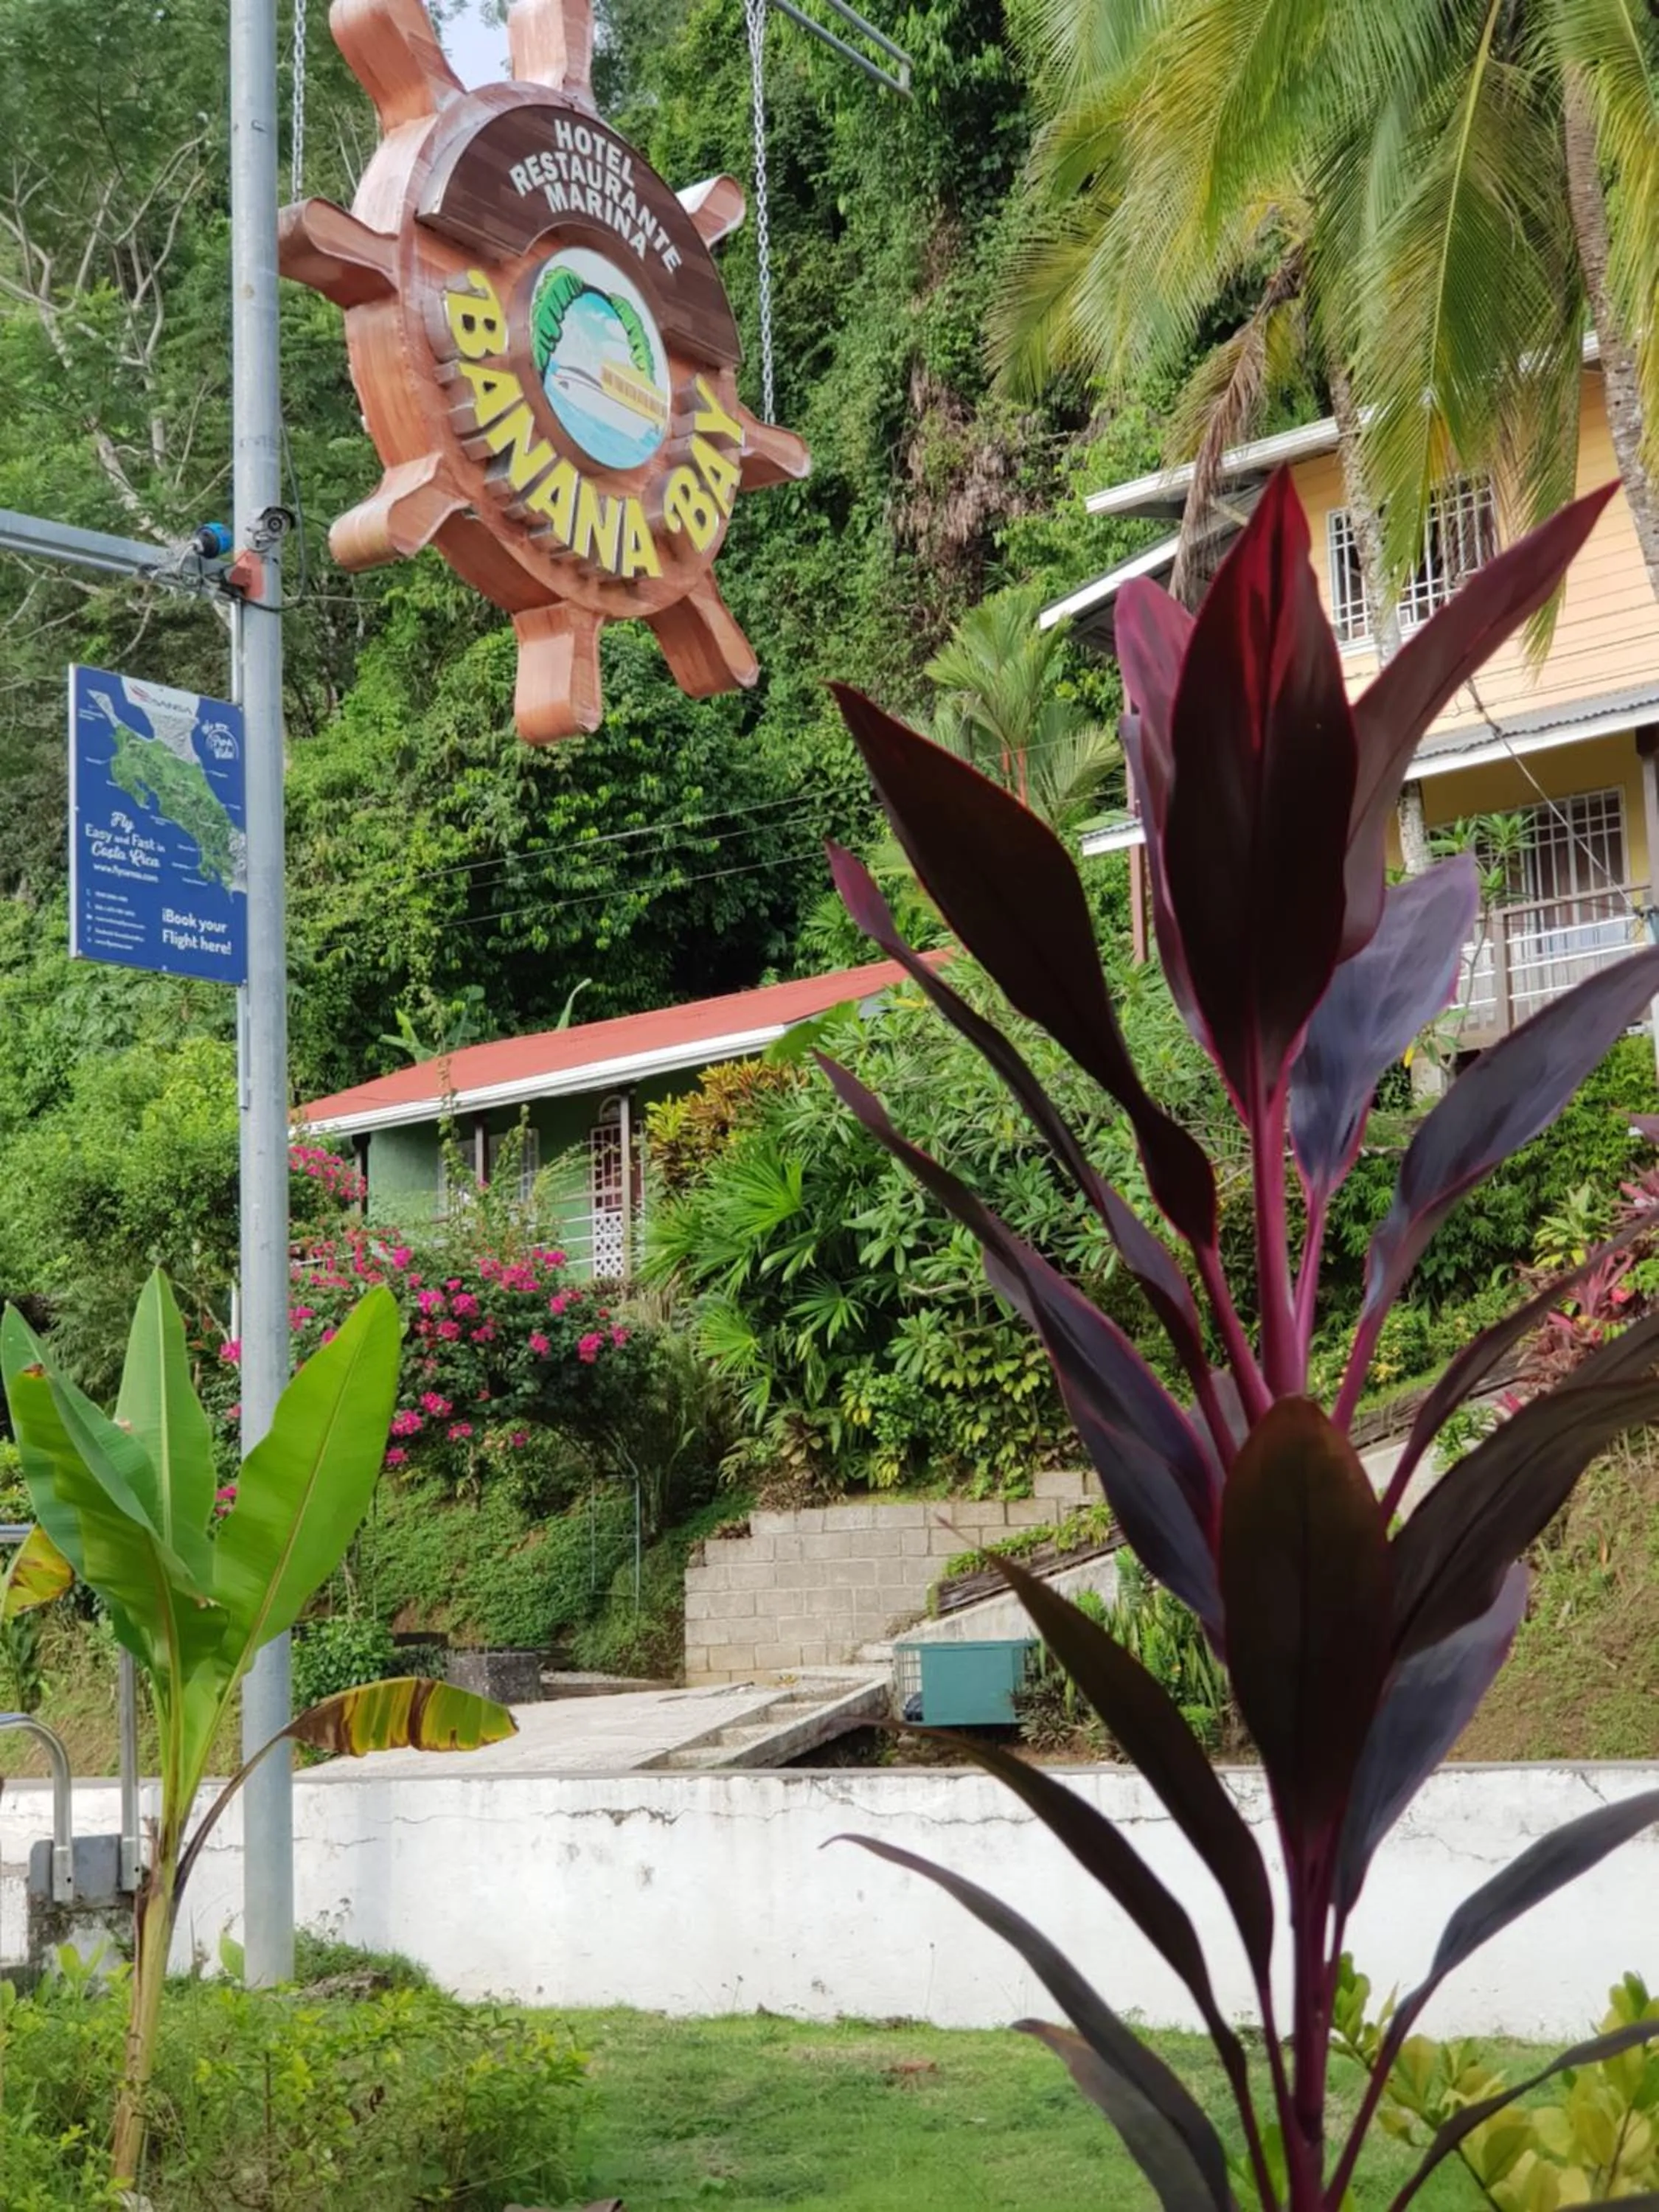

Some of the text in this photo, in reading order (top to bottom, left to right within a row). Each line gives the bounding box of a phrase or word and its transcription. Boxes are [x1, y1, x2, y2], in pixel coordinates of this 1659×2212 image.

[554, 119, 636, 187] HOTEL
[509, 150, 683, 274] RESTAURANTE
[544, 181, 648, 260] MARINA
[444, 268, 745, 580] BANANA BAY
[85, 823, 113, 844] Easy
[132, 833, 155, 851] Fast
[91, 841, 127, 860] Costa
[129, 849, 160, 868] Rica
[162, 928, 198, 950] Flight
[200, 935, 232, 956] here!
[198, 919, 228, 934] your
